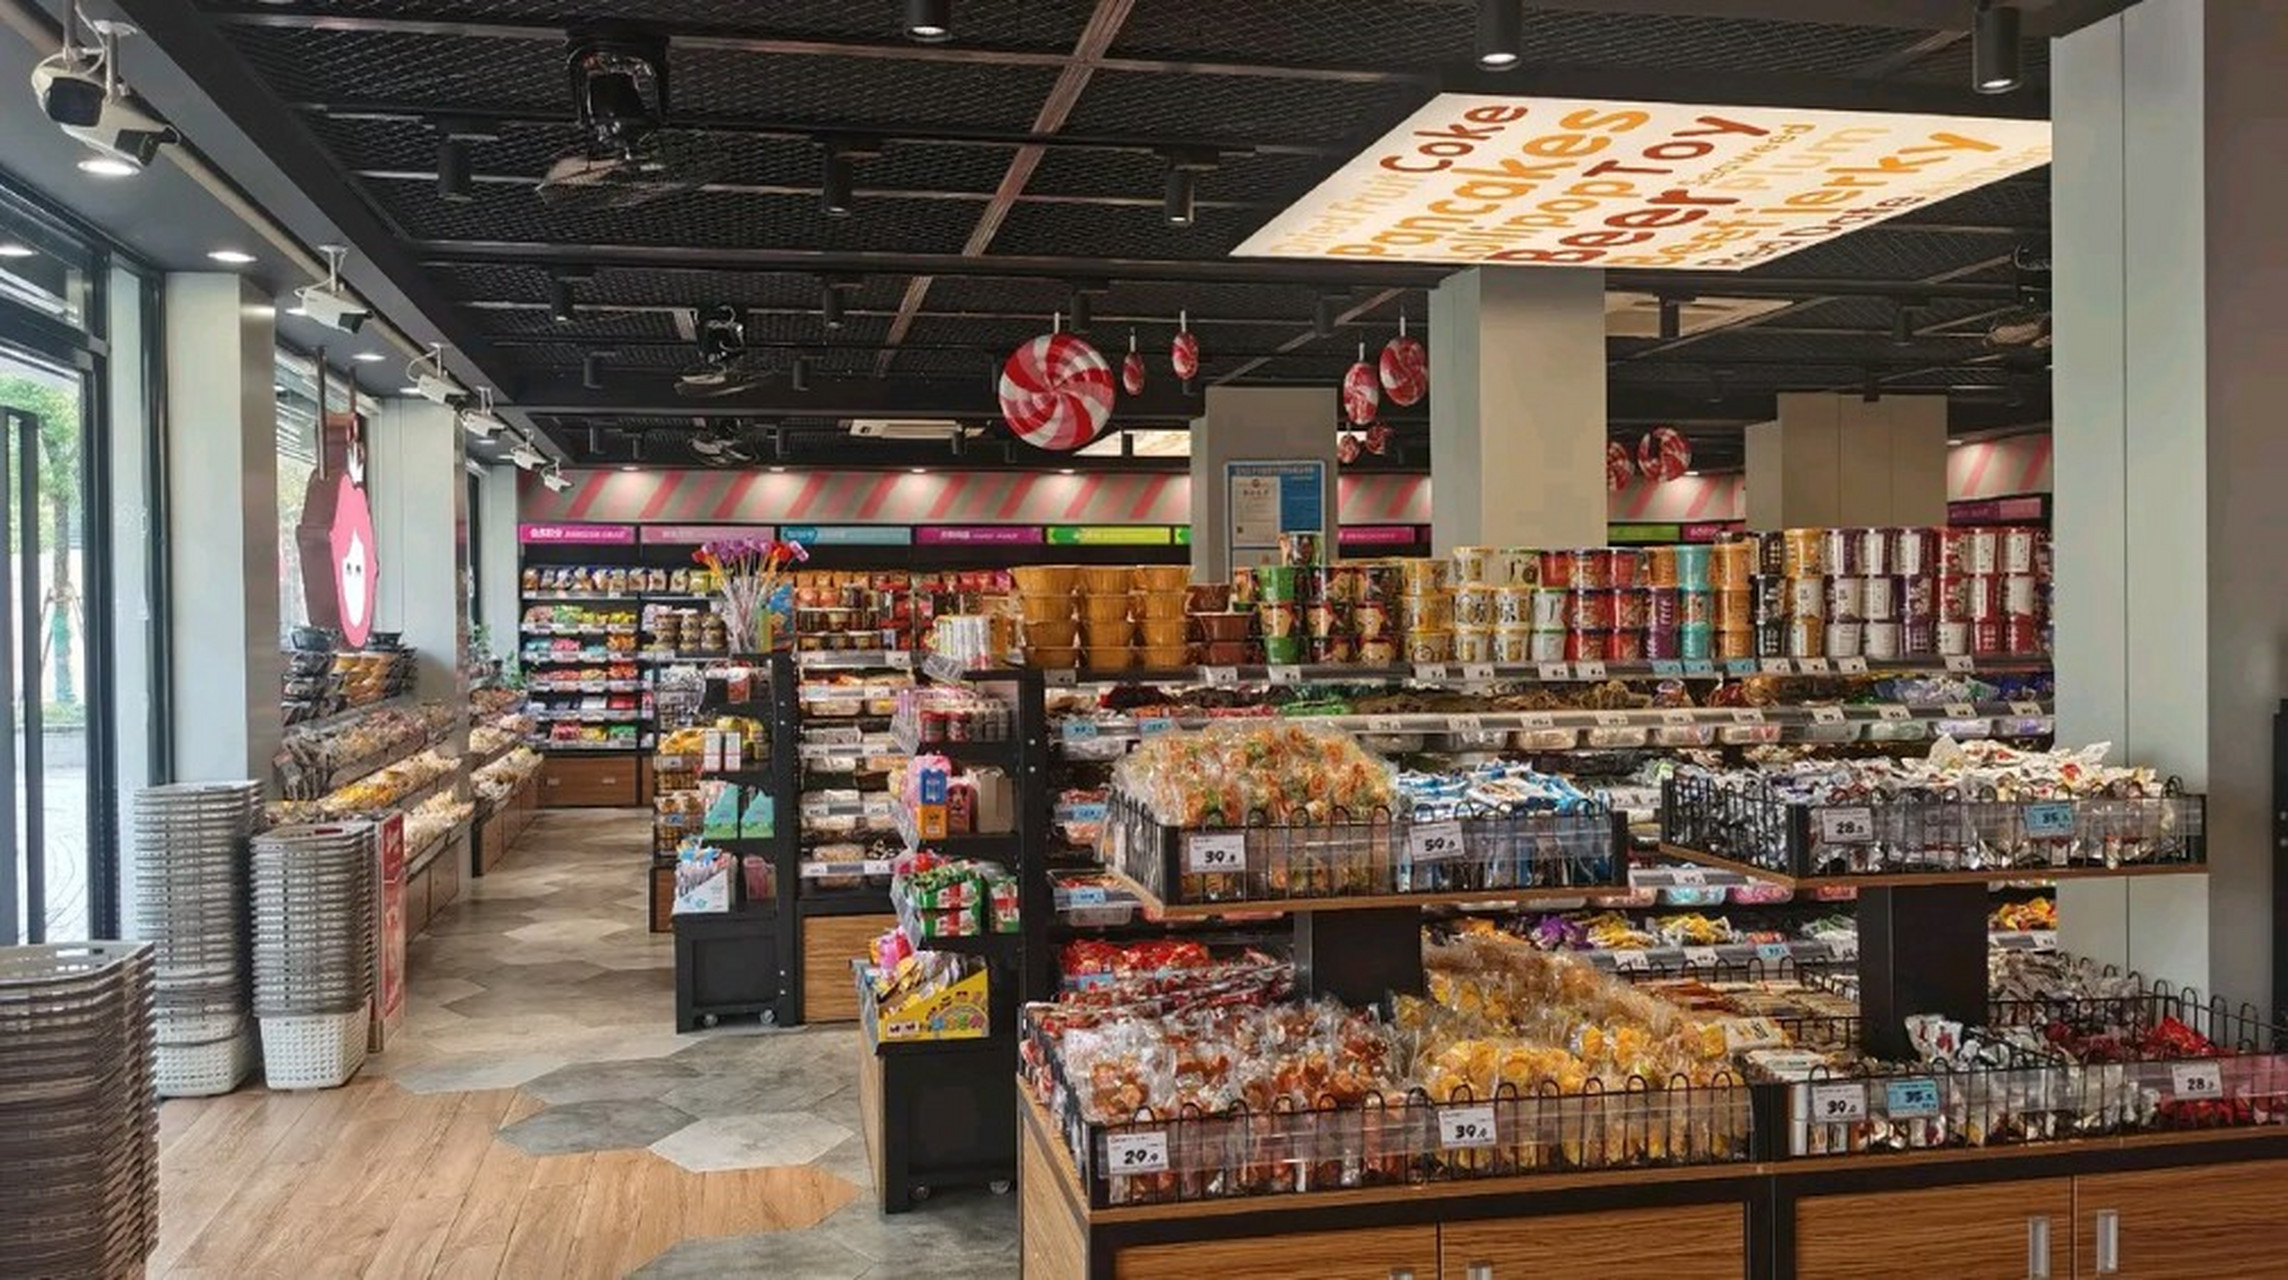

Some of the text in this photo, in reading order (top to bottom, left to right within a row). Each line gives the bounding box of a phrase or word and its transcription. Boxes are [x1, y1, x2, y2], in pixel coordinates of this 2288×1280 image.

[1379, 104, 1529, 173] Coke
[1581, 115, 1771, 178] Toy
[1325, 107, 1652, 258] Pancakes
[1484, 188, 1741, 263] Beer
